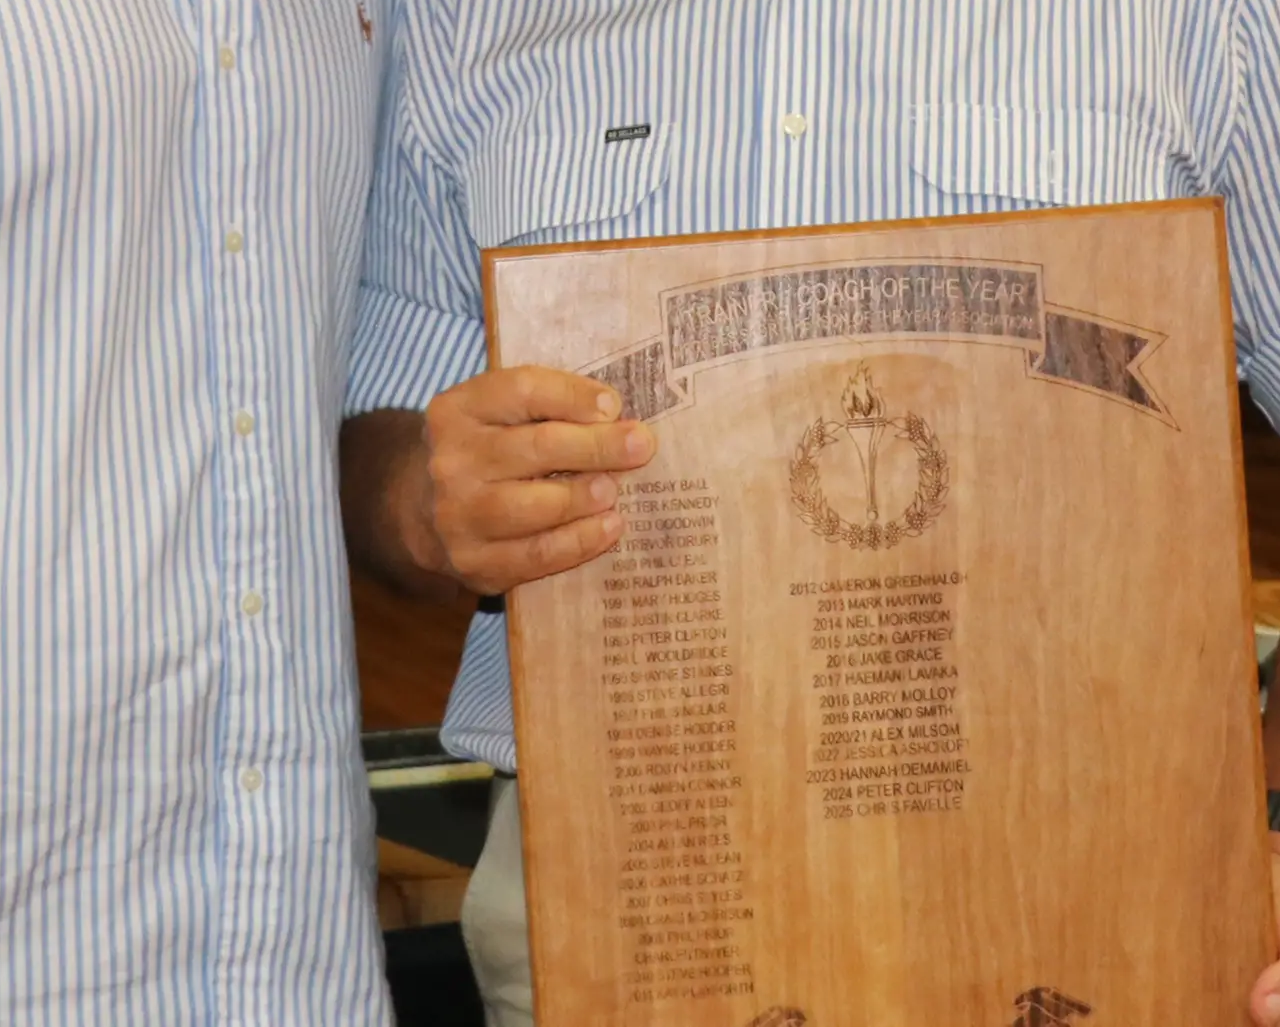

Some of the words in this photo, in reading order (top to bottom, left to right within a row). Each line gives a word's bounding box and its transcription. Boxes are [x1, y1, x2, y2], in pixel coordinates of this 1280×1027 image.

[797, 278, 874, 306] COACH
[881, 277, 910, 305] OF
[916, 277, 960, 298] THE
[966, 278, 1025, 306] YEAR
[626, 480, 677, 495] LINDSAY
[681, 478, 708, 491] BALL
[620, 500, 659, 514] PETER
[662, 496, 719, 510] KENNEDY
[629, 520, 652, 532] TED
[655, 514, 715, 531] GOODWIN
[625, 536, 674, 551] TREVOR
[677, 535, 719, 549] DRURY
[633, 575, 673, 589] RALPH
[789, 581, 817, 596] 2012
[820, 576, 881, 593] CAMERON
[884, 571, 968, 590] GREENHALGH
[669, 591, 721, 605] HODGES
[817, 598, 845, 613] 2013
[848, 595, 883, 610] MARK
[886, 591, 943, 607] HARTWIG
[632, 612, 674, 627] JUSTIN
[676, 609, 724, 623] CLARKE
[813, 617, 843, 632] 2014
[846, 614, 875, 629] NEIL
[878, 609, 951, 627] MORRISON
[632, 631, 672, 646] PETER
[675, 627, 727, 642] CLIFTON
[811, 635, 841, 650] 2015
[844, 631, 888, 648] JASON
[891, 626, 954, 645] GAFFNEY
[826, 653, 856, 669] 2016
[859, 650, 892, 666] JAKE
[895, 646, 943, 664] GRACE
[813, 673, 842, 689] 2017
[908, 664, 959, 682] LAVAKA
[637, 687, 677, 702] STEVE
[820, 693, 850, 709] 2018
[853, 689, 897, 707] BARRY
[901, 685, 958, 703] MOLLOY
[822, 711, 850, 726] 2019
[852, 706, 913, 723] RAYMOND
[916, 703, 954, 719] SMITH
[821, 729, 868, 746] 2020/21
[870, 726, 904, 742] ALEX
[908, 722, 960, 738] MILSOM
[806, 769, 837, 784] 2023
[840, 765, 898, 781] HANNAH
[901, 758, 973, 777] DEMAMIEL
[822, 786, 853, 802] 2024
[857, 782, 902, 798] PETER
[906, 778, 964, 795] CLIFTON
[823, 804, 854, 820] 2025
[857, 799, 900, 818] CHRIS
[903, 795, 963, 813] FAVELLE
